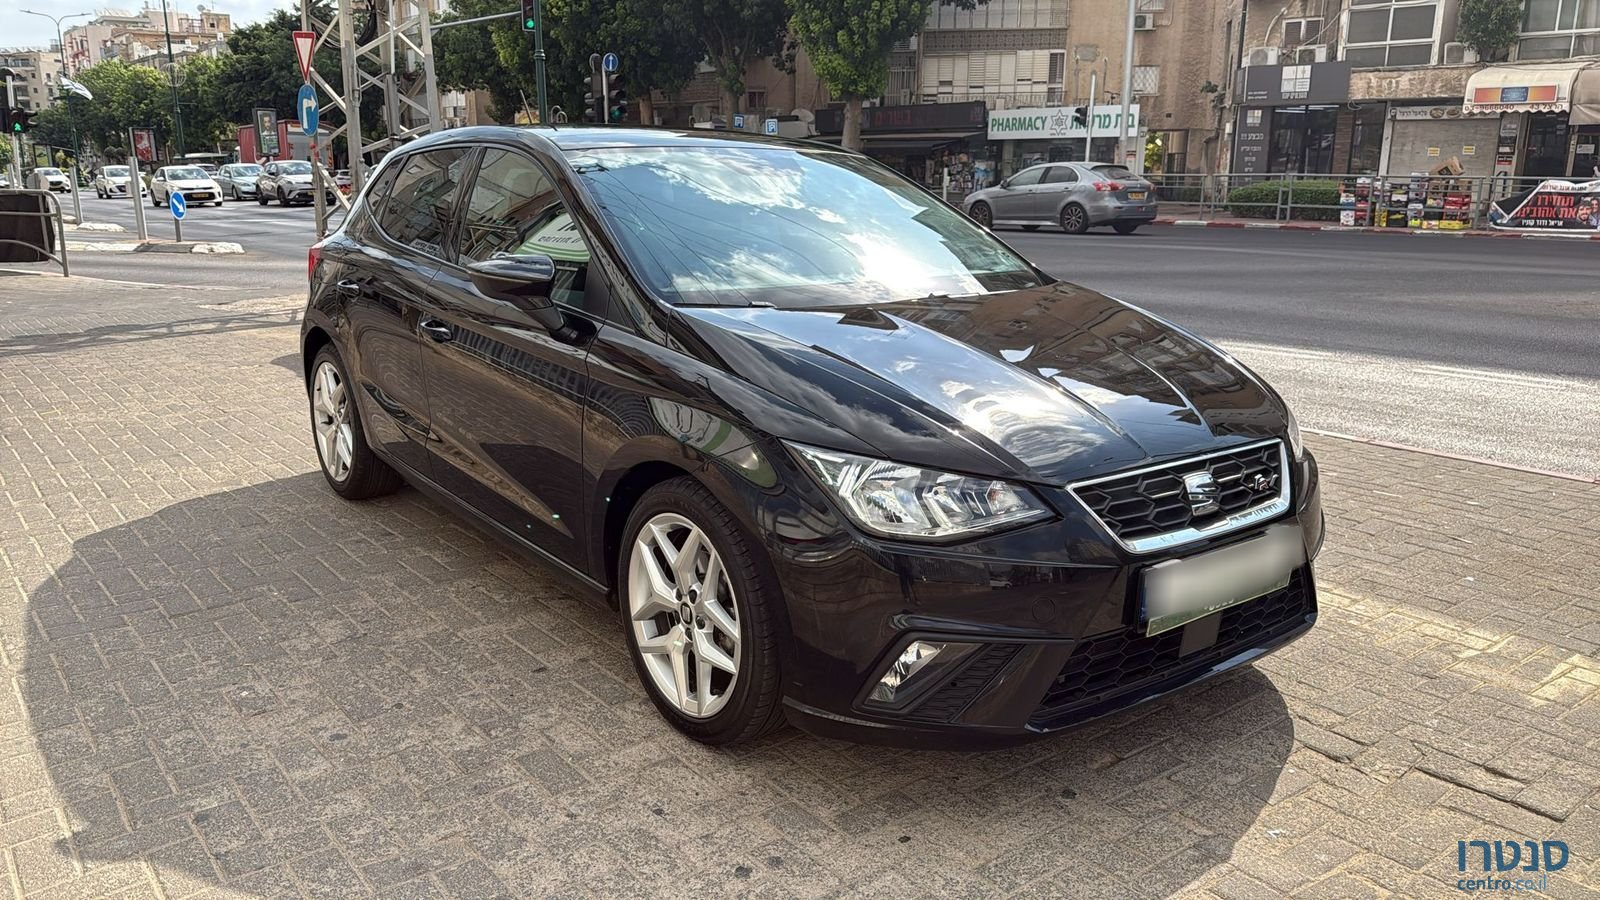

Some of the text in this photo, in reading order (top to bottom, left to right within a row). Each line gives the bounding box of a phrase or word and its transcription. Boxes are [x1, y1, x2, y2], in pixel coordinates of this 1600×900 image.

[990, 115, 1048, 132] PHARMACY
[1069, 113, 1136, 130] בת מרת
[1559, 206, 1577, 218] את
